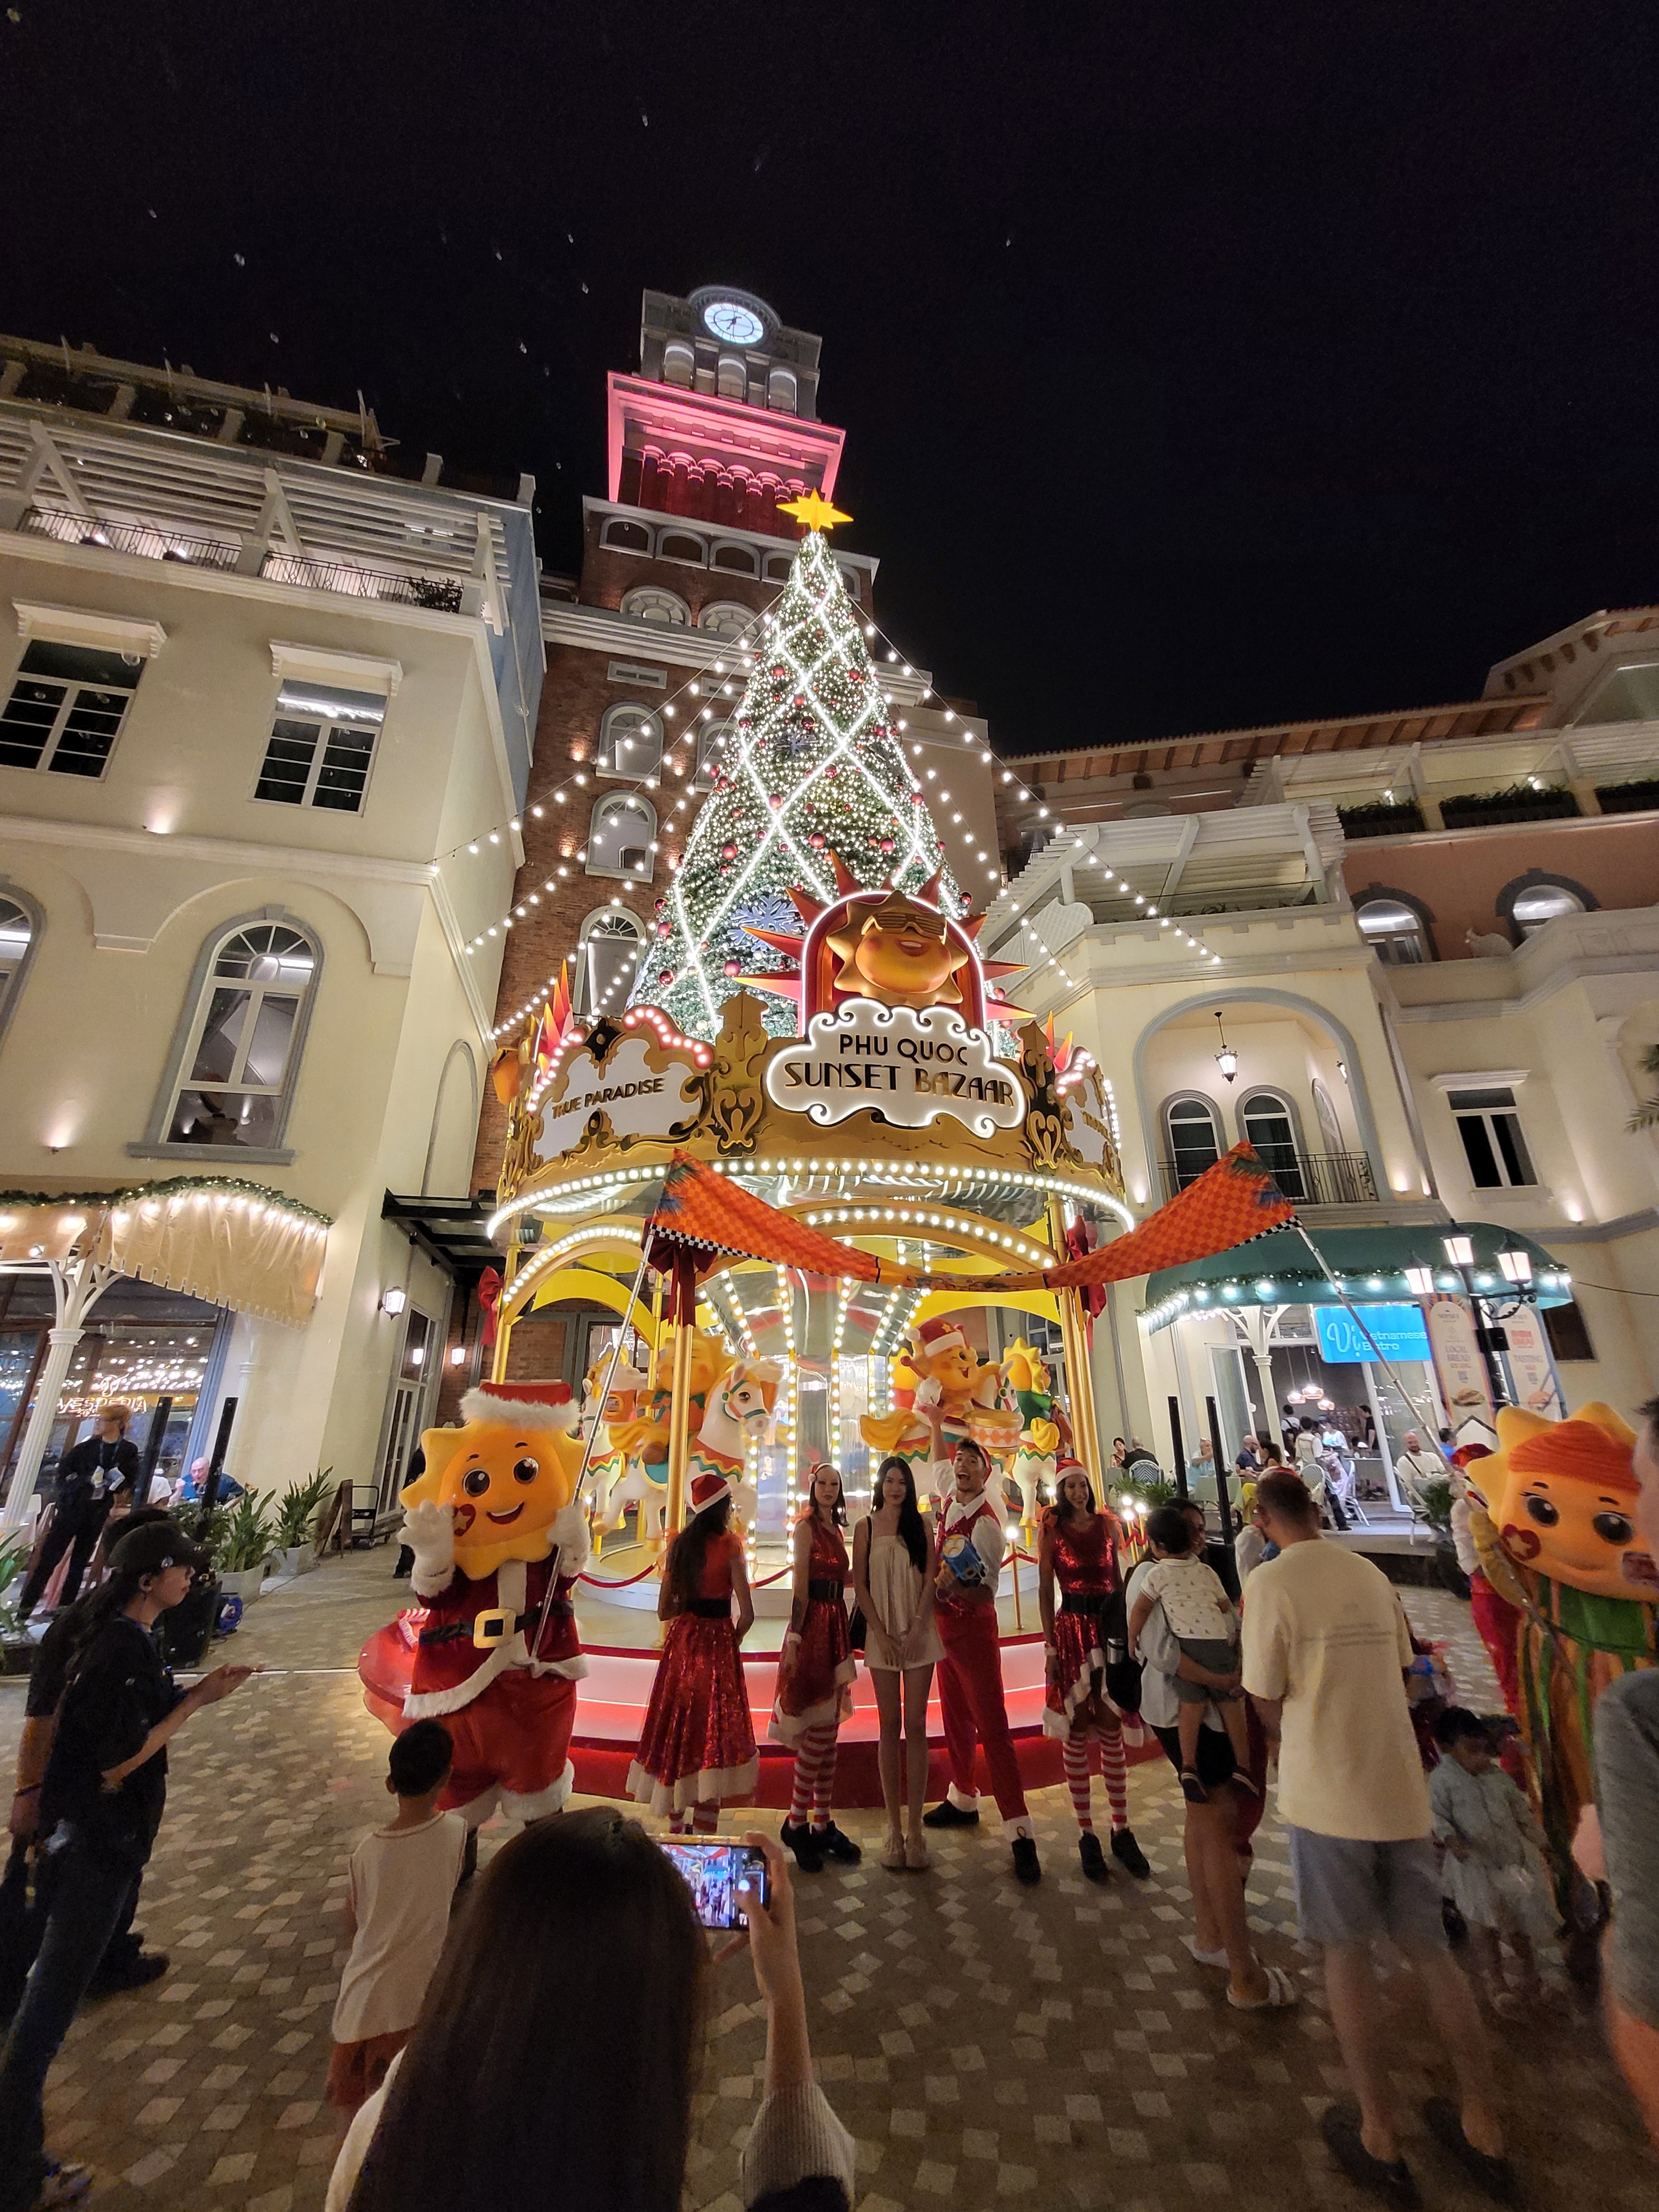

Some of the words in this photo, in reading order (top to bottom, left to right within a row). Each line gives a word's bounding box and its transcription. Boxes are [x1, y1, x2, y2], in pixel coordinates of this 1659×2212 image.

[839, 1034, 888, 1056] PHU
[897, 1038, 968, 1066] QUOC
[552, 1097, 582, 1119] TRUE
[584, 1078, 665, 1108] PARADISE
[784, 1062, 901, 1091] SUNSET
[915, 1068, 1014, 1107] BAZAAR
[1359, 1331, 1428, 1340] Vetnamese
[1362, 1341, 1400, 1350] Btro
